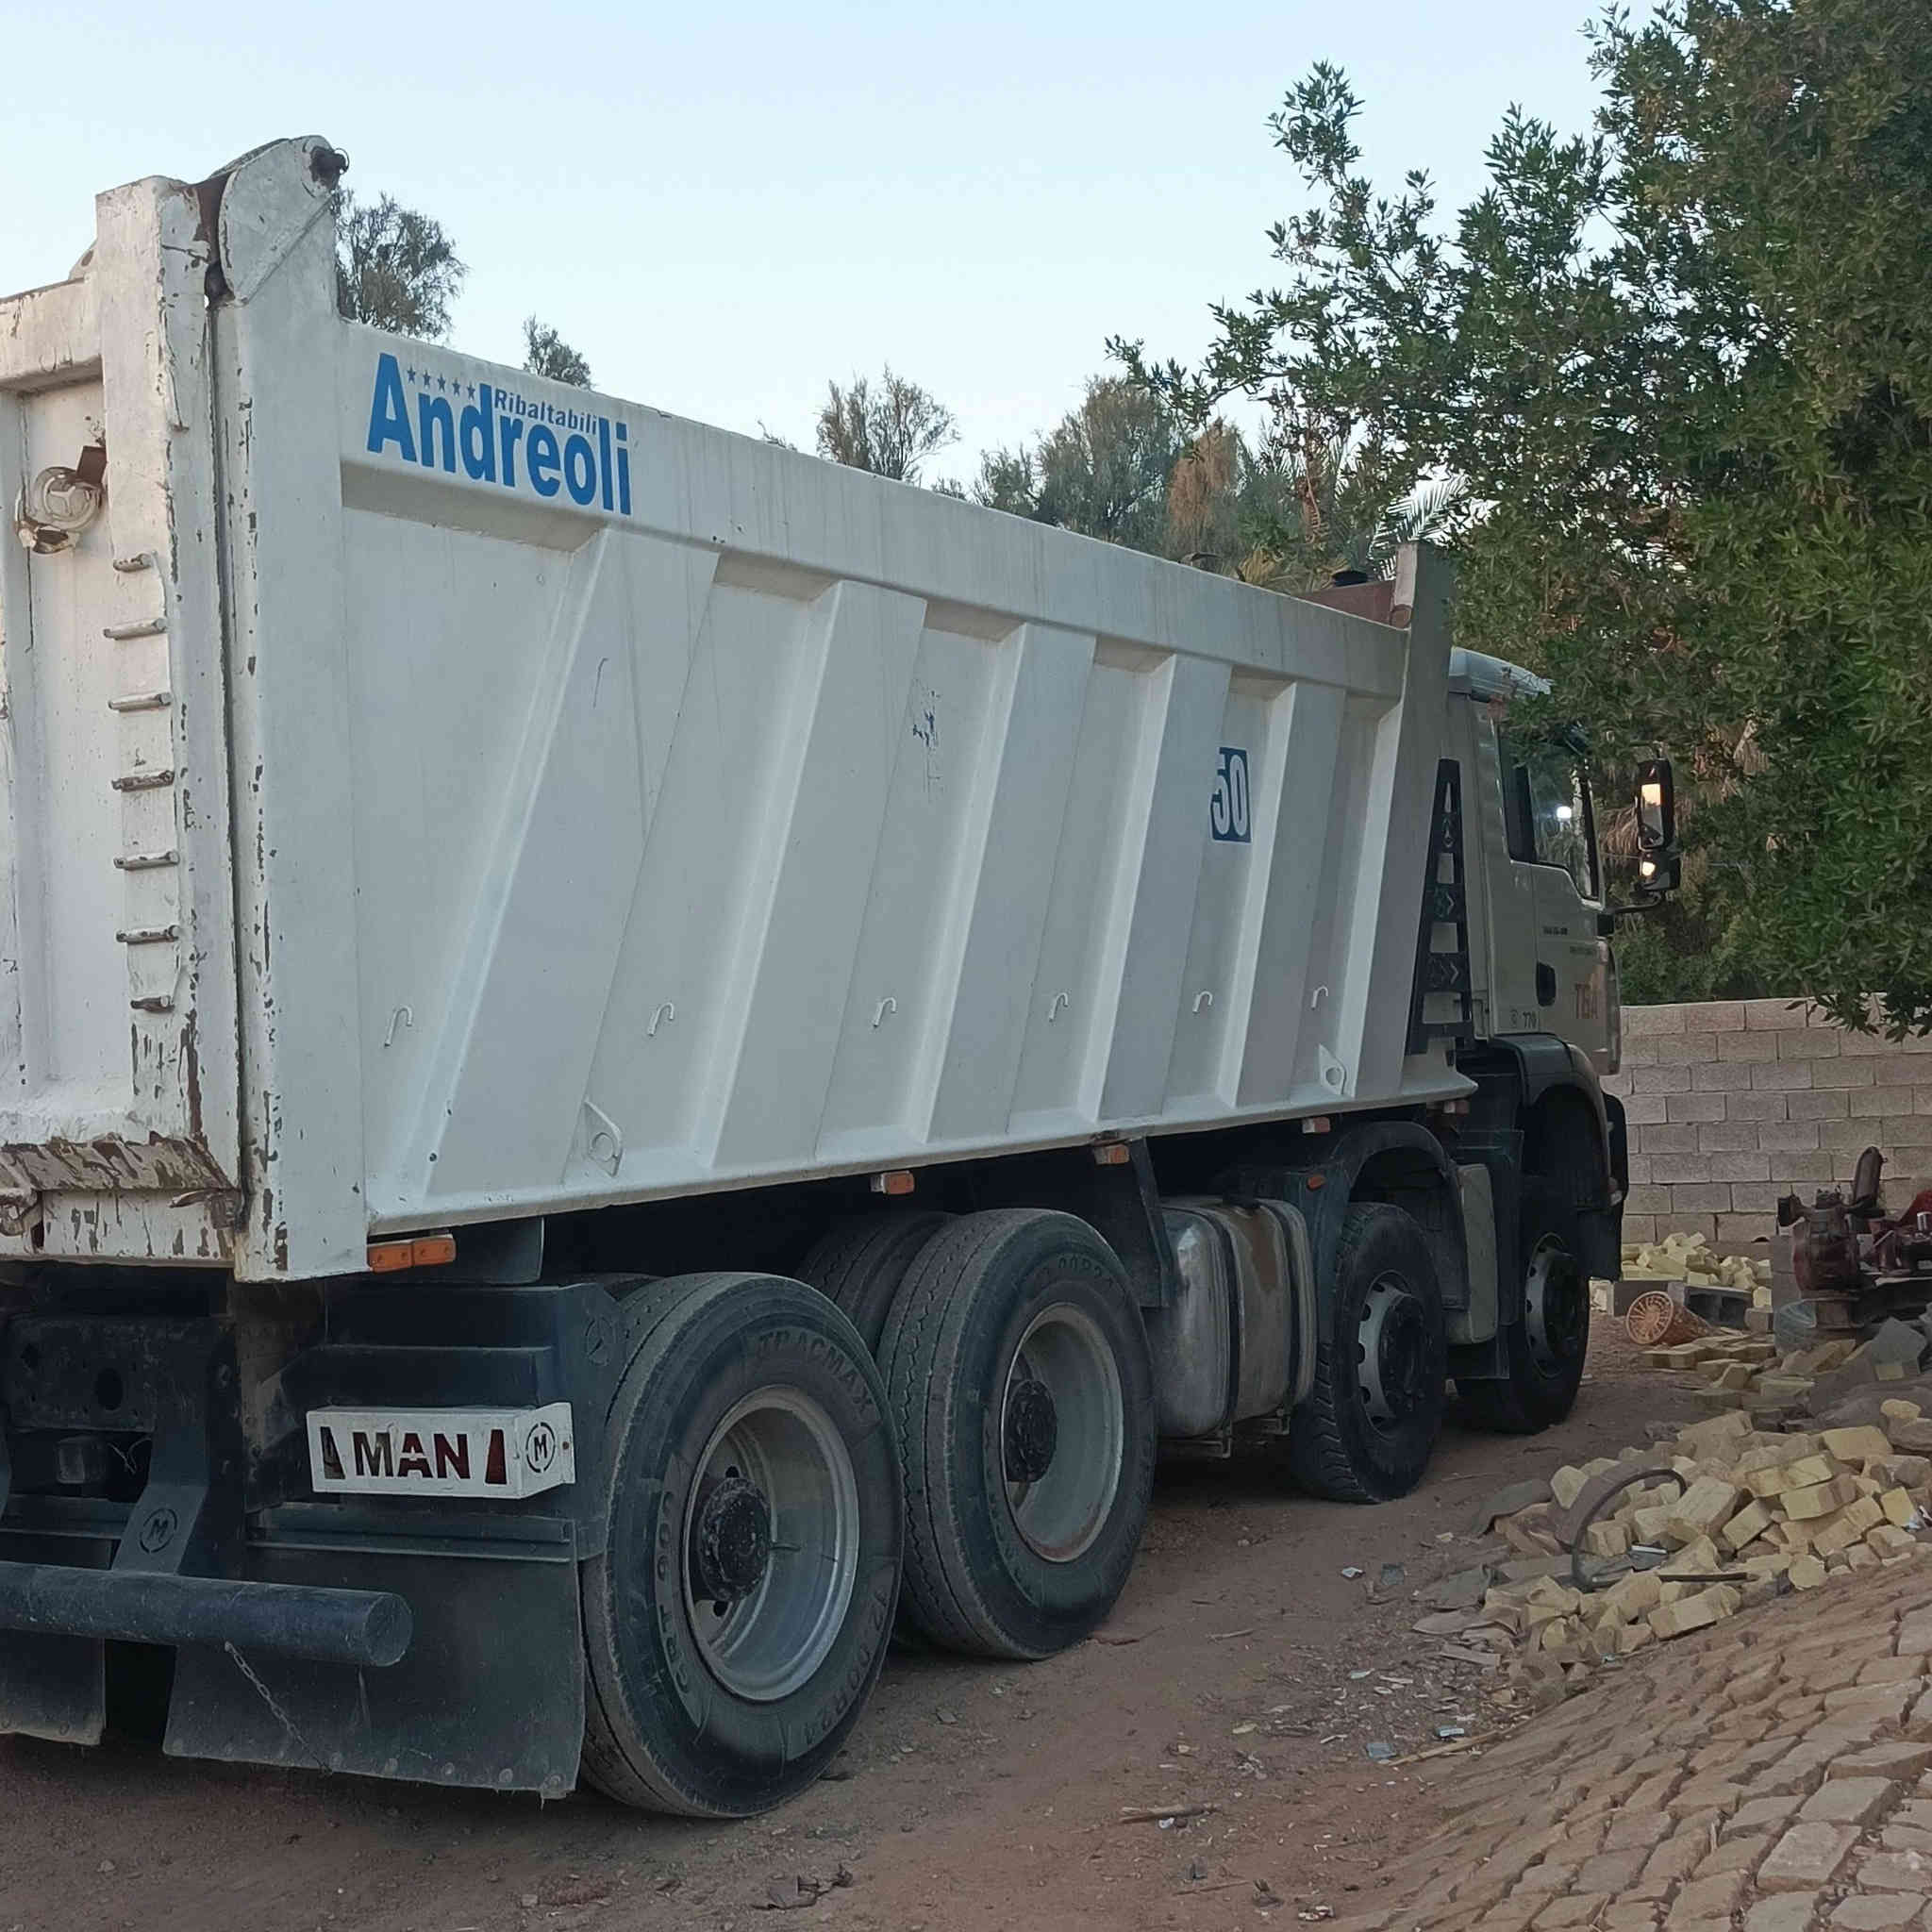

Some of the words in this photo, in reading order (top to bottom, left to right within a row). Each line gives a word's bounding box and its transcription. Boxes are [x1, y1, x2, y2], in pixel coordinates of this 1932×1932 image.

[367, 353, 631, 515] Andreoli
[494, 388, 597, 435] Ribaltabili
[352, 1431, 471, 1479] MAN
